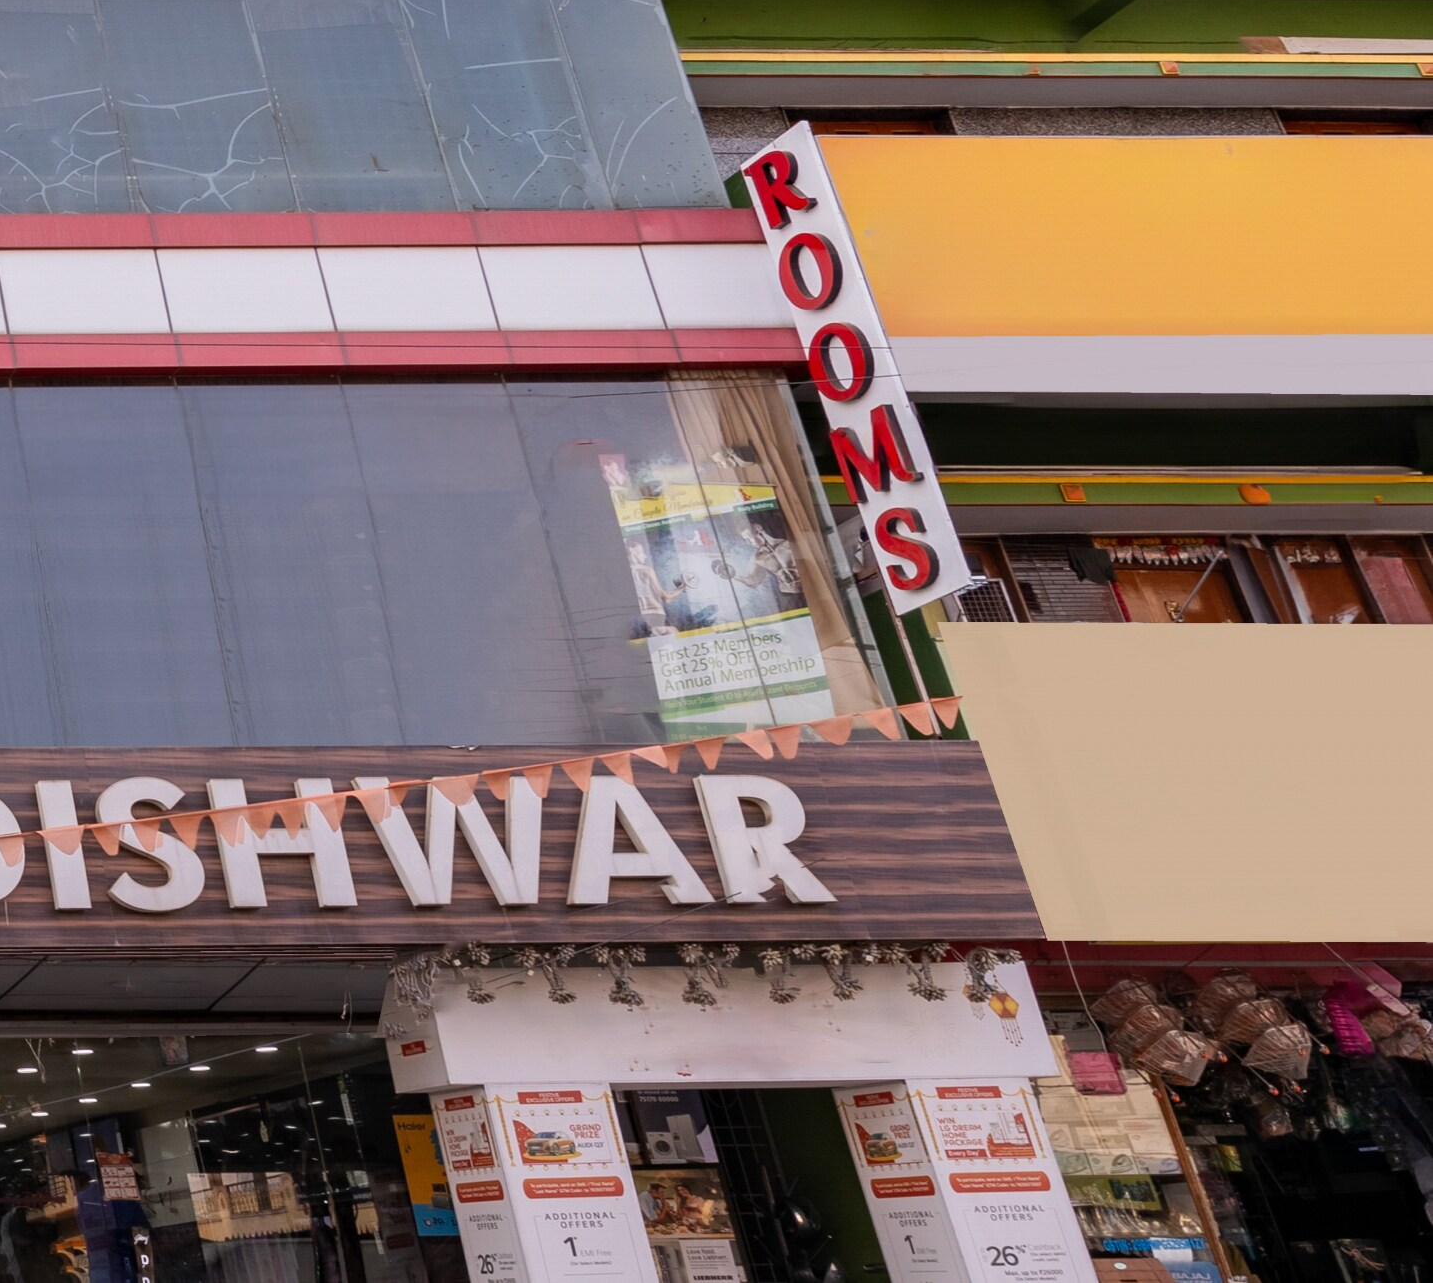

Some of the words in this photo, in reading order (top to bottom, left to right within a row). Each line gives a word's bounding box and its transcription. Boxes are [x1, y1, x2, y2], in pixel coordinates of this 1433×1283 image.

[743, 150, 940, 592] ROOMS
[658, 646, 689, 663] First
[692, 643, 710, 658] 25
[714, 632, 782, 653] Members
[661, 661, 688, 678] Get
[691, 656, 723, 673] 25%
[726, 650, 755, 667] OFF
[760, 648, 779, 661] on
[664, 673, 717, 693] Annual
[720, 656, 816, 684] Membership
[397, 1122, 426, 1130] Haier
[569, 1124, 602, 1132] GRAND
[974, 1205, 1045, 1213] ADDITIONAL
[469, 1214, 503, 1222] ADDITIONAL
[544, 1211, 616, 1220] ADDITIONAL
[889, 1211, 934, 1219] ADDITIONAL
[990, 1213, 1034, 1221] OFFERS
[477, 1222, 498, 1230] OFFERS
[560, 1220, 604, 1229] OFFERS
[899, 1219, 928, 1227] OFFERS
